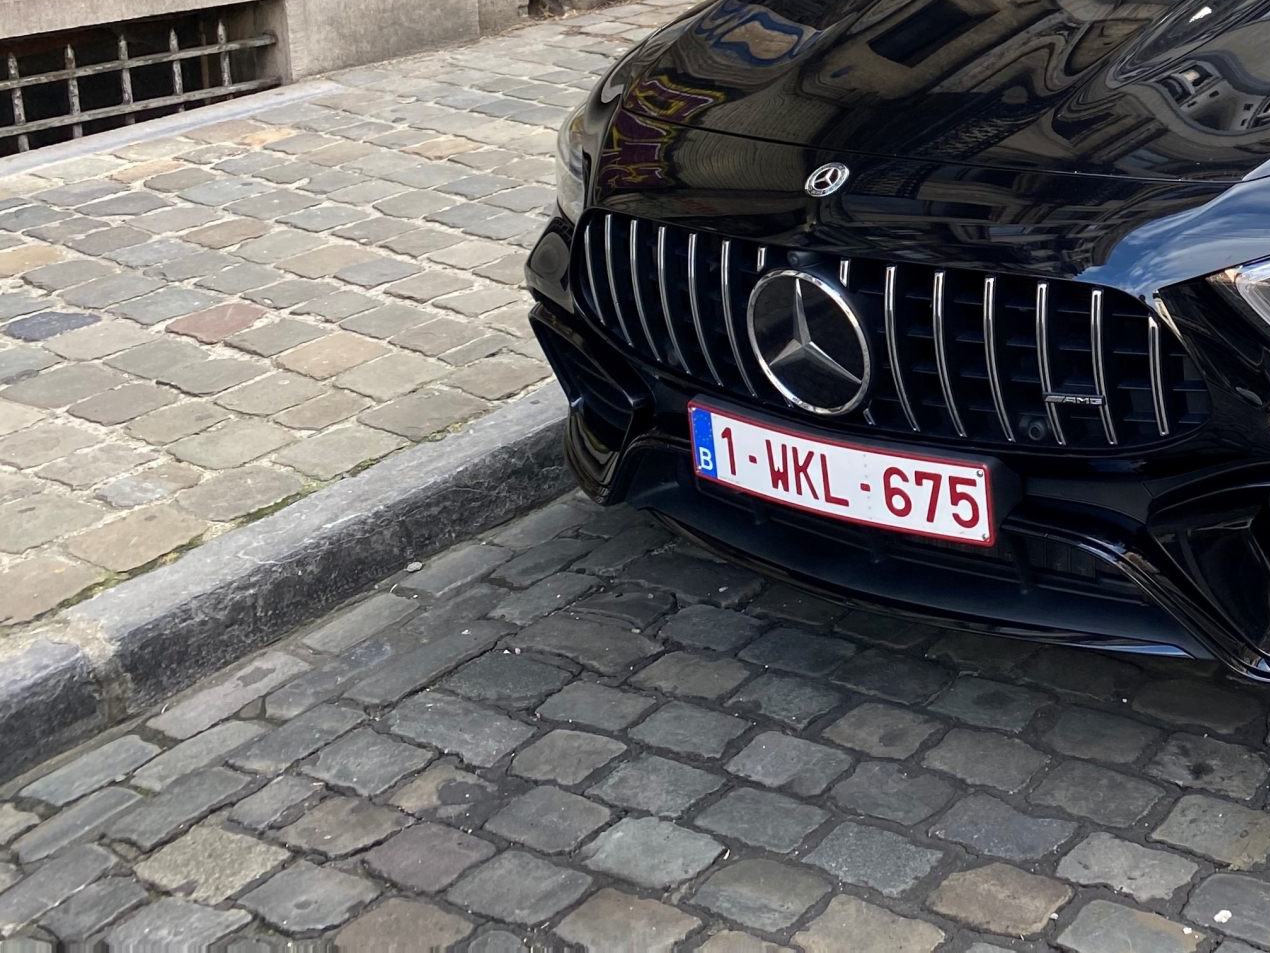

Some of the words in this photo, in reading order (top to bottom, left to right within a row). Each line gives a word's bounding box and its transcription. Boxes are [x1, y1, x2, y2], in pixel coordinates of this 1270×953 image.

[1063, 396, 1103, 405] AMG
[699, 446, 714, 471] B
[720, 426, 981, 529] 1-WKL-675
